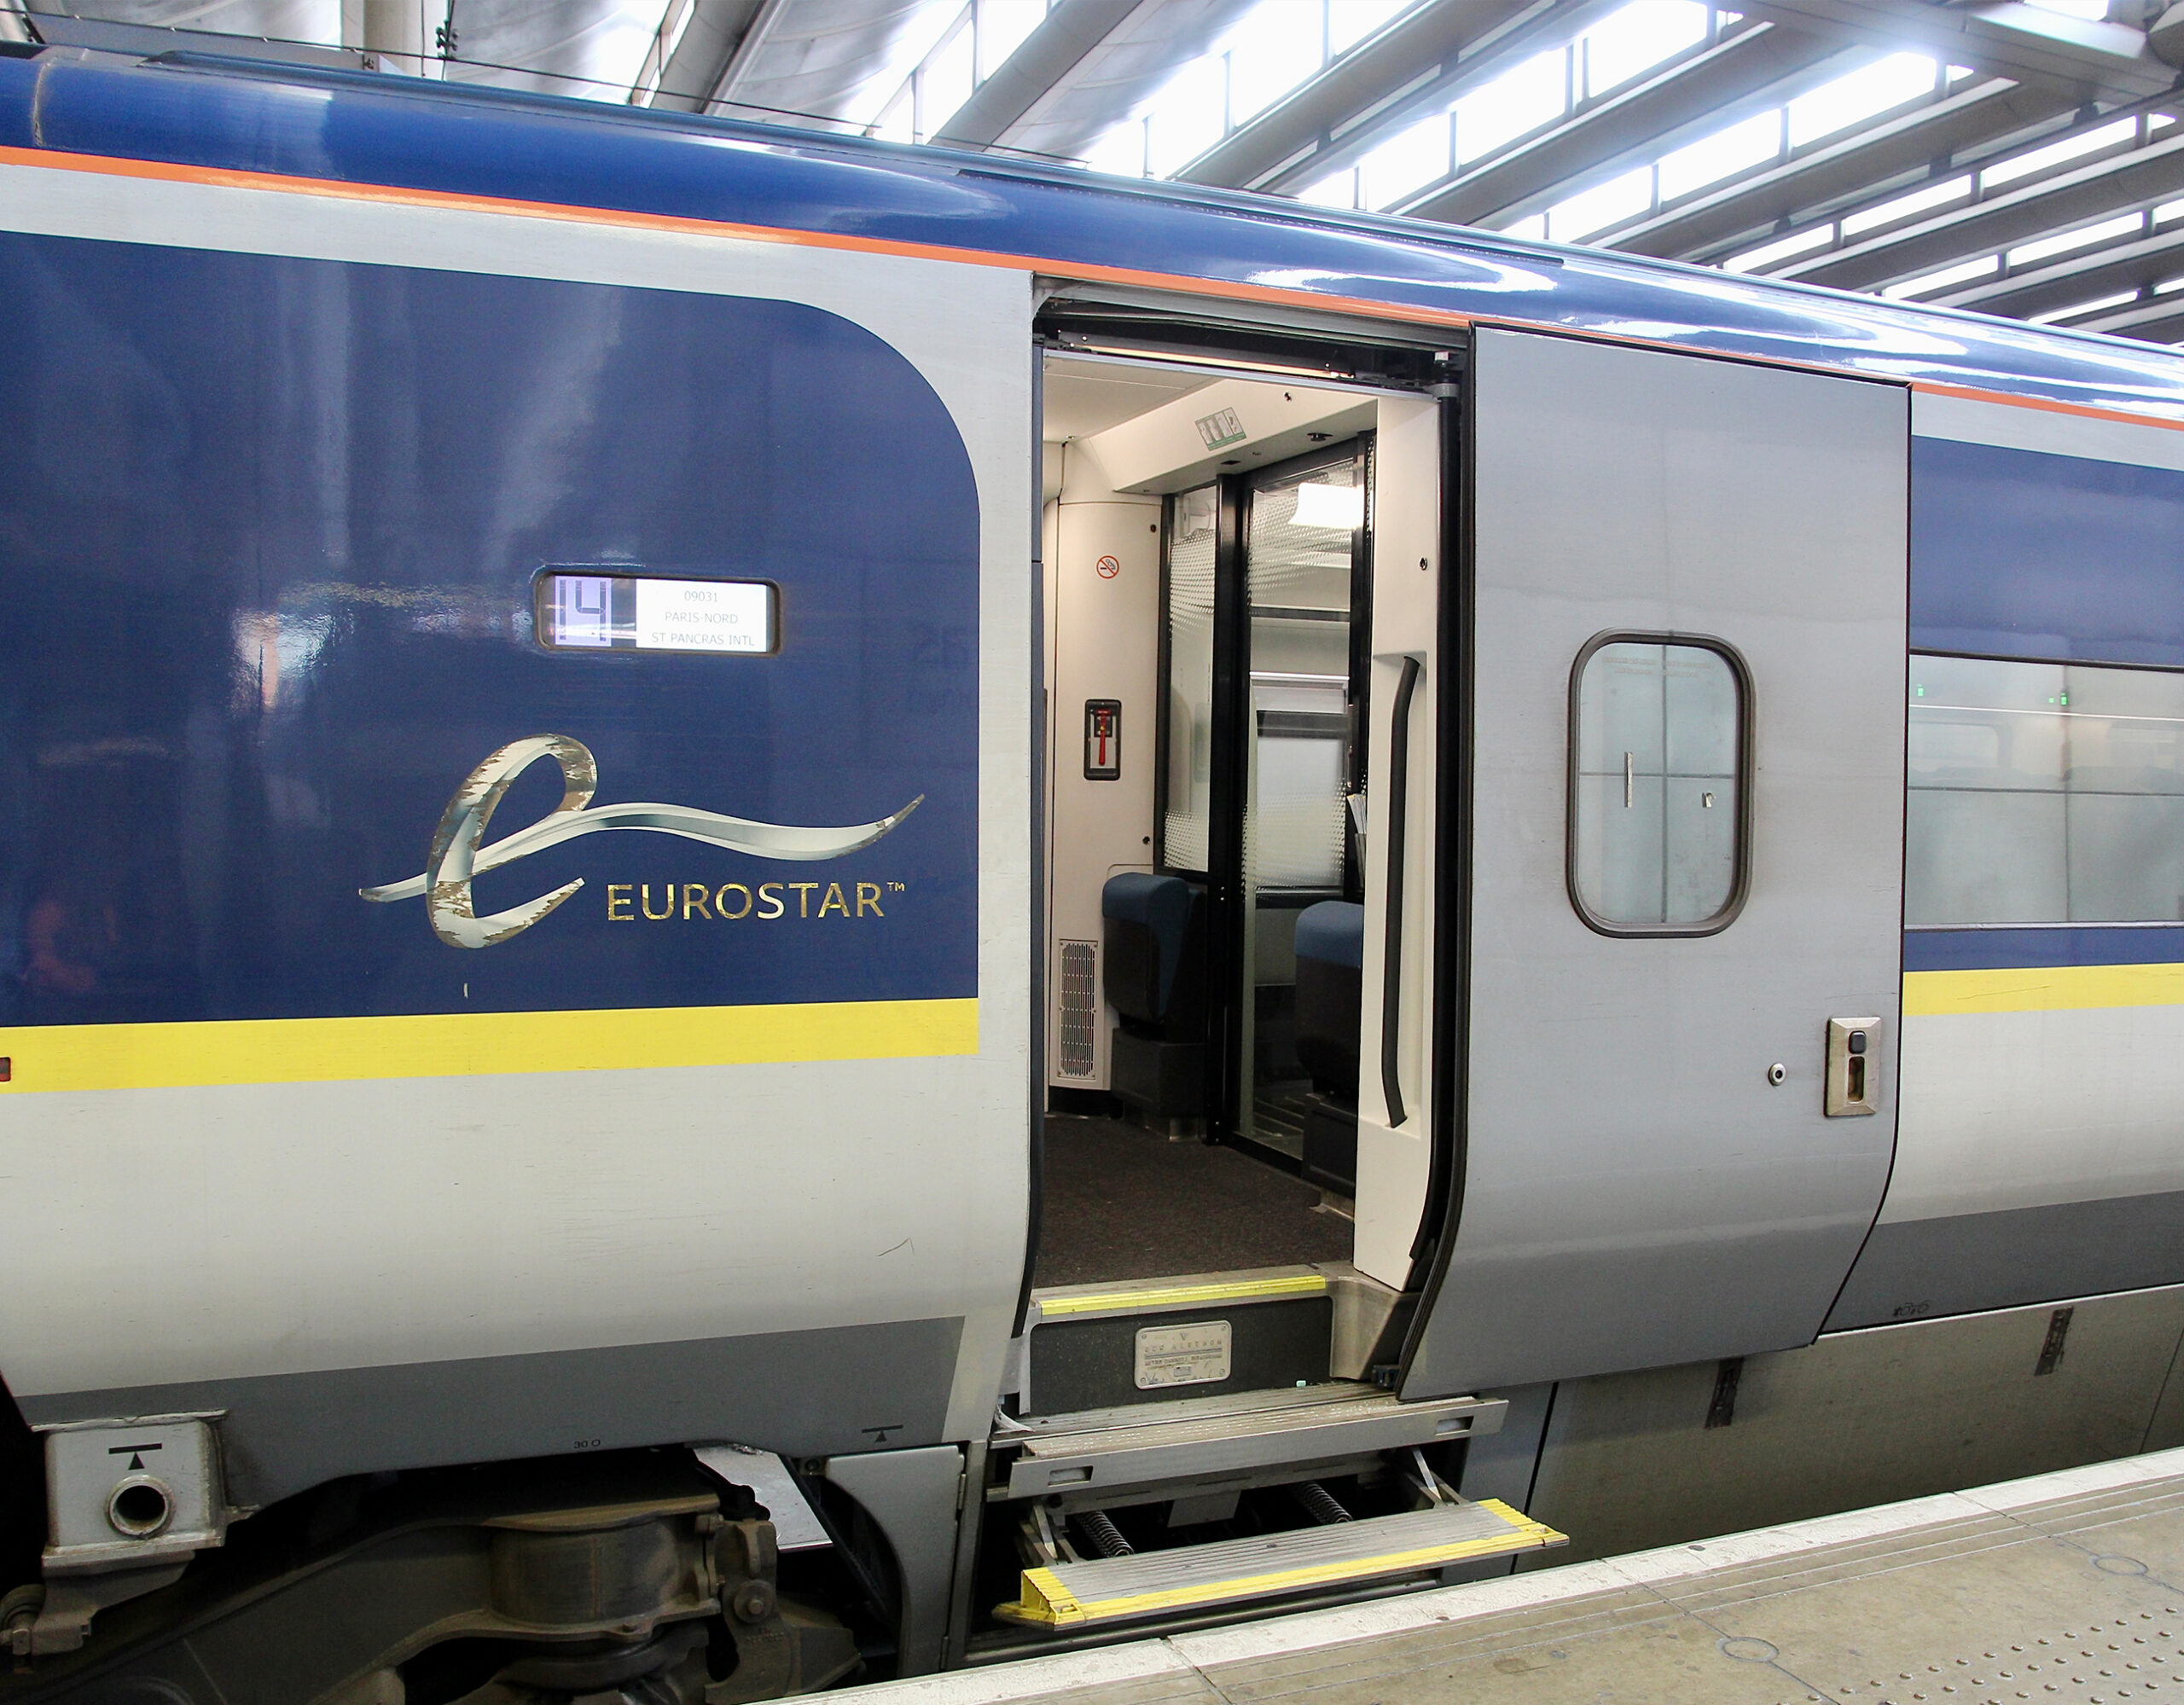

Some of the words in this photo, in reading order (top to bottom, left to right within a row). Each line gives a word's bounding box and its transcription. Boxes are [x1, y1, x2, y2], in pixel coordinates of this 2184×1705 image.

[684, 590, 717, 602] 09031
[665, 612, 739, 623] PARIS-NORD
[652, 632, 665, 642] ST
[671, 633, 724, 644] PANCRAS
[729, 635, 755, 646] INTL
